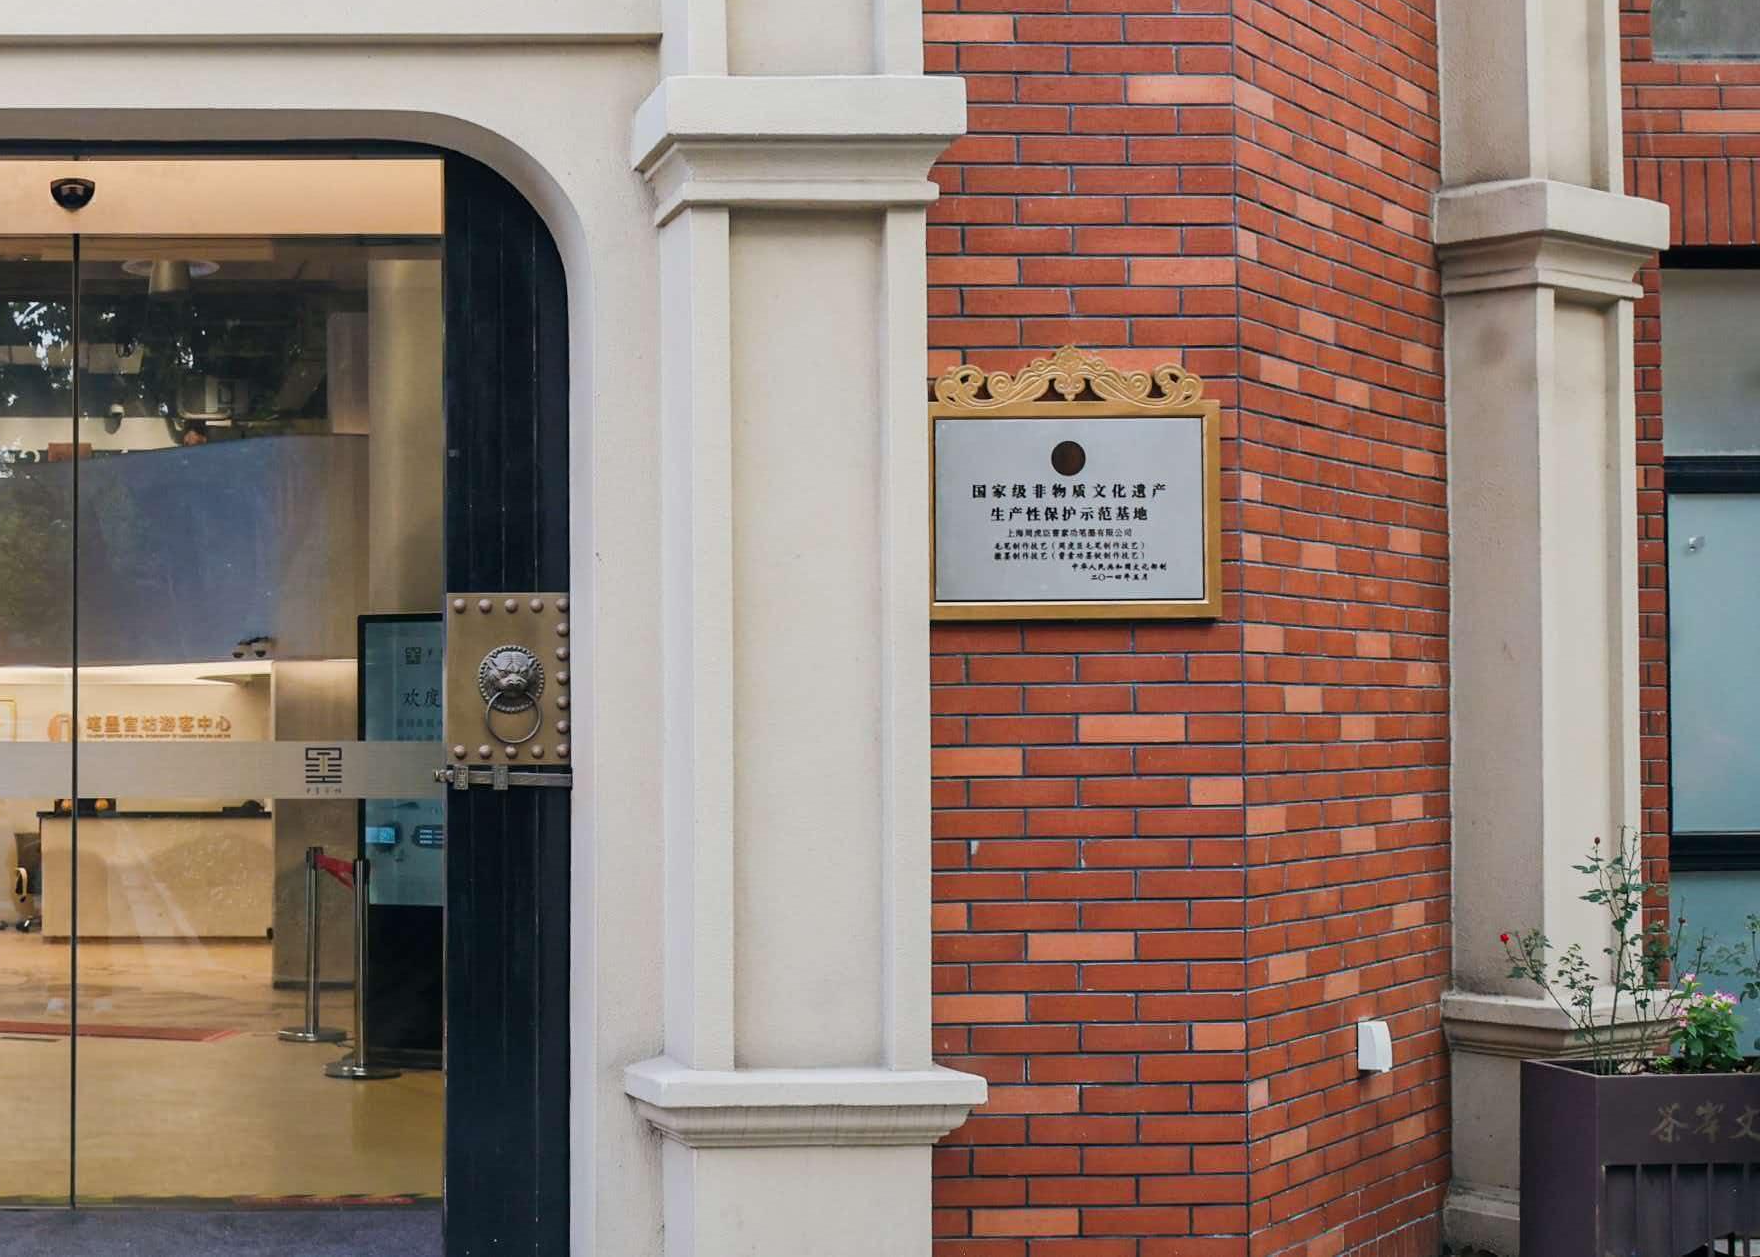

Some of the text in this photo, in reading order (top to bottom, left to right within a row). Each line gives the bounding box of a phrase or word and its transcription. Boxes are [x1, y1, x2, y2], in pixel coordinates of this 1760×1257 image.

[972, 483, 1167, 500] 国家级非物质文化遗产
[991, 506, 1149, 522] 生产性保护示范基地
